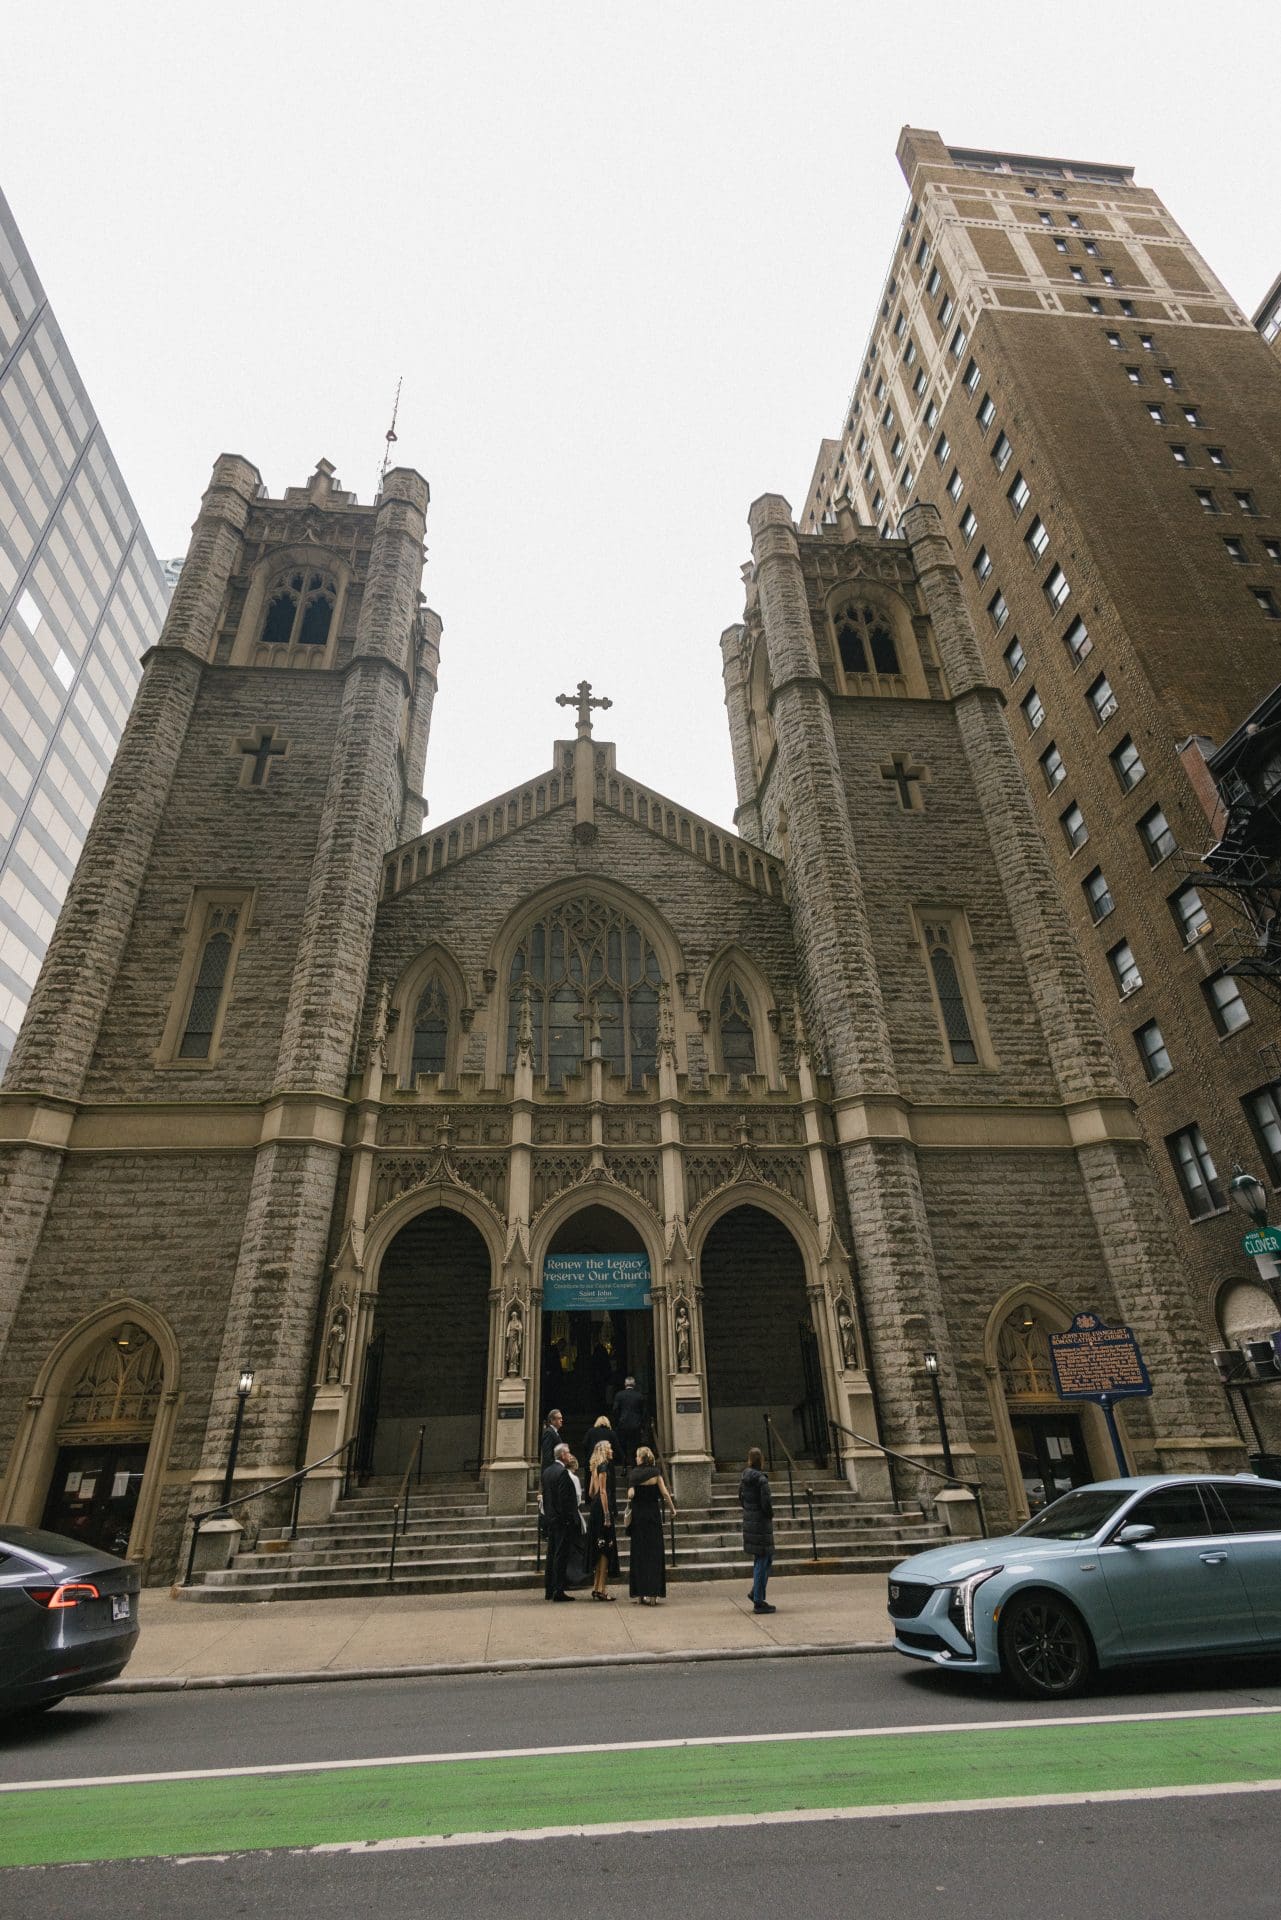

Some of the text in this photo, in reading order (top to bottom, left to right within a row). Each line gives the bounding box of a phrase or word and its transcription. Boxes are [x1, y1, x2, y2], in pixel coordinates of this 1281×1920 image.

[1245, 1237, 1279, 1254] CLOVER
[547, 1259, 643, 1271] Renew the Legacy
[588, 1271, 609, 1281] Our
[613, 1270, 651, 1280] Church
[1104, 1333, 1130, 1341] CHURCH
